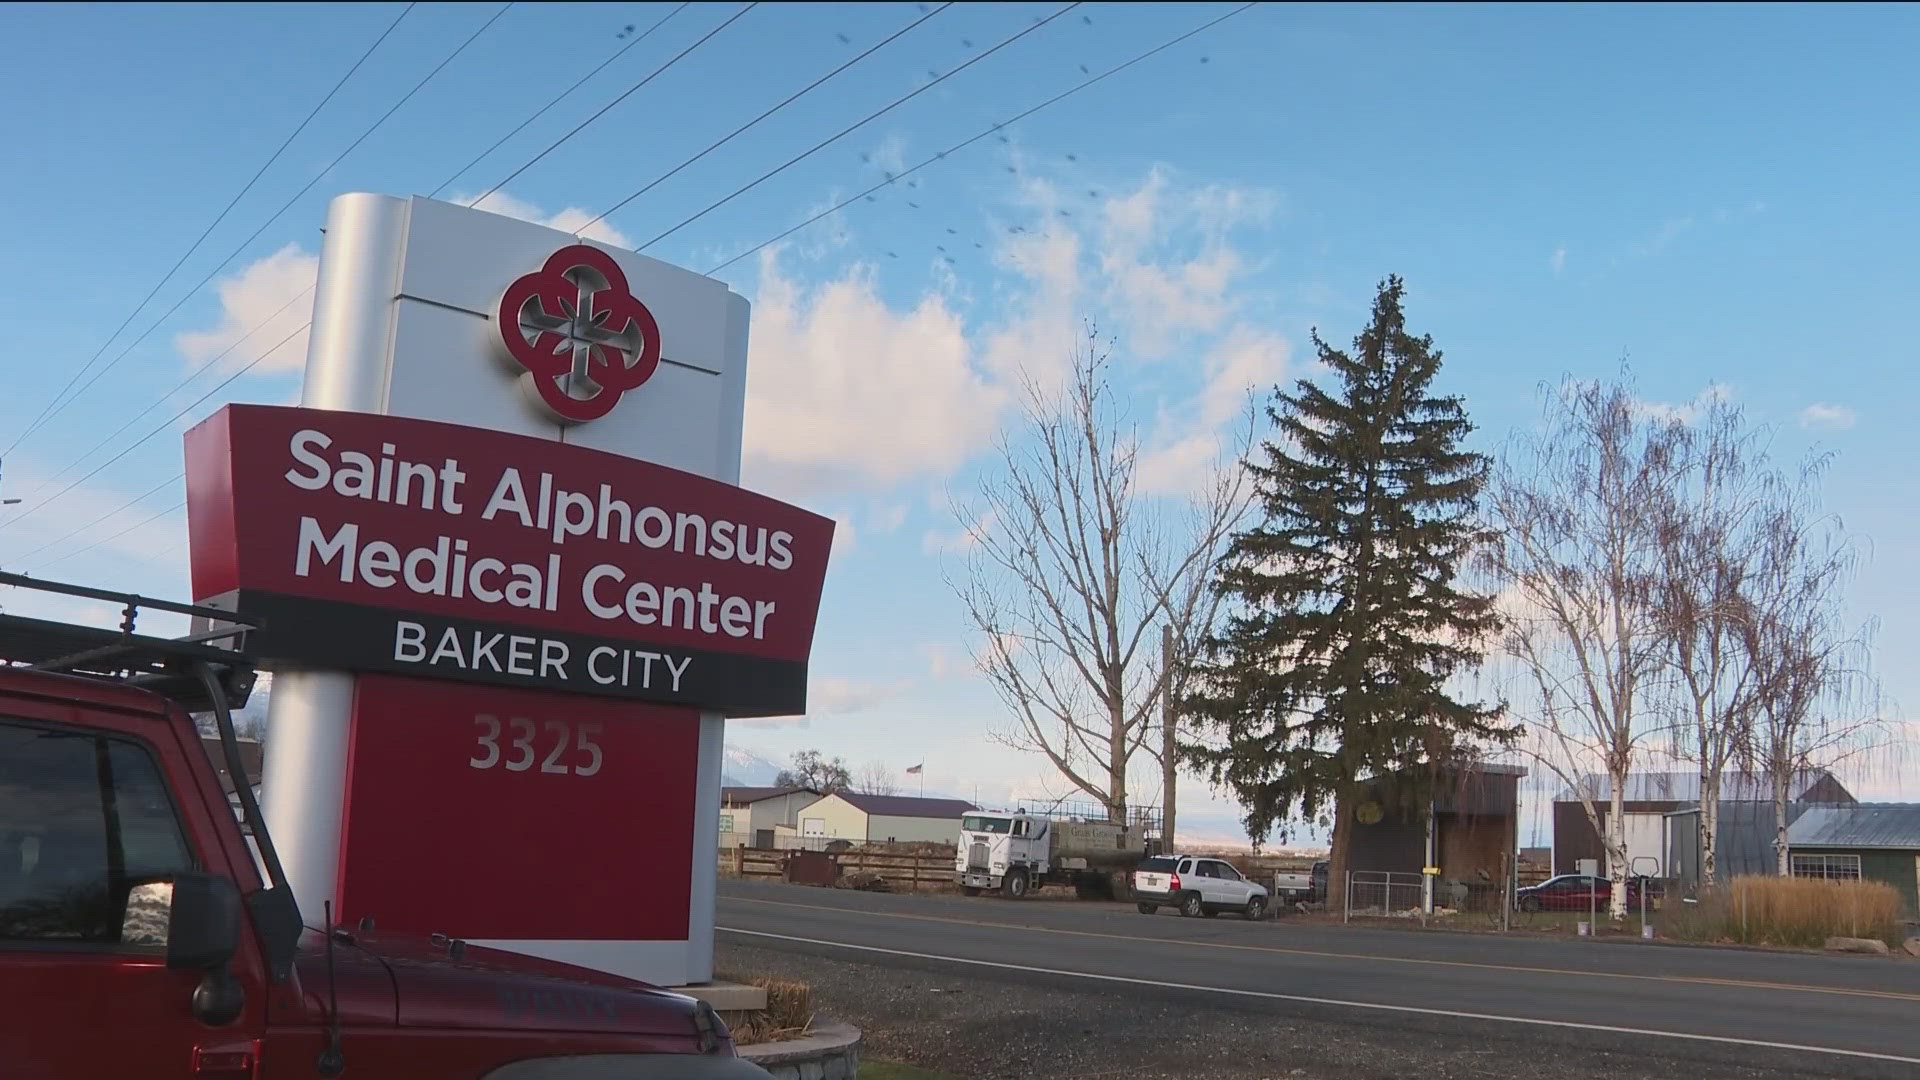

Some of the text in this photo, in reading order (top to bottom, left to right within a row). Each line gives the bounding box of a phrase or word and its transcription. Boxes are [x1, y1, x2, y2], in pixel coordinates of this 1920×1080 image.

[285, 429, 794, 570] Saint Alphonsus
[295, 516, 776, 640] Medical Center
[394, 620, 693, 692] BAKER CITY
[470, 713, 603, 777] 3325
